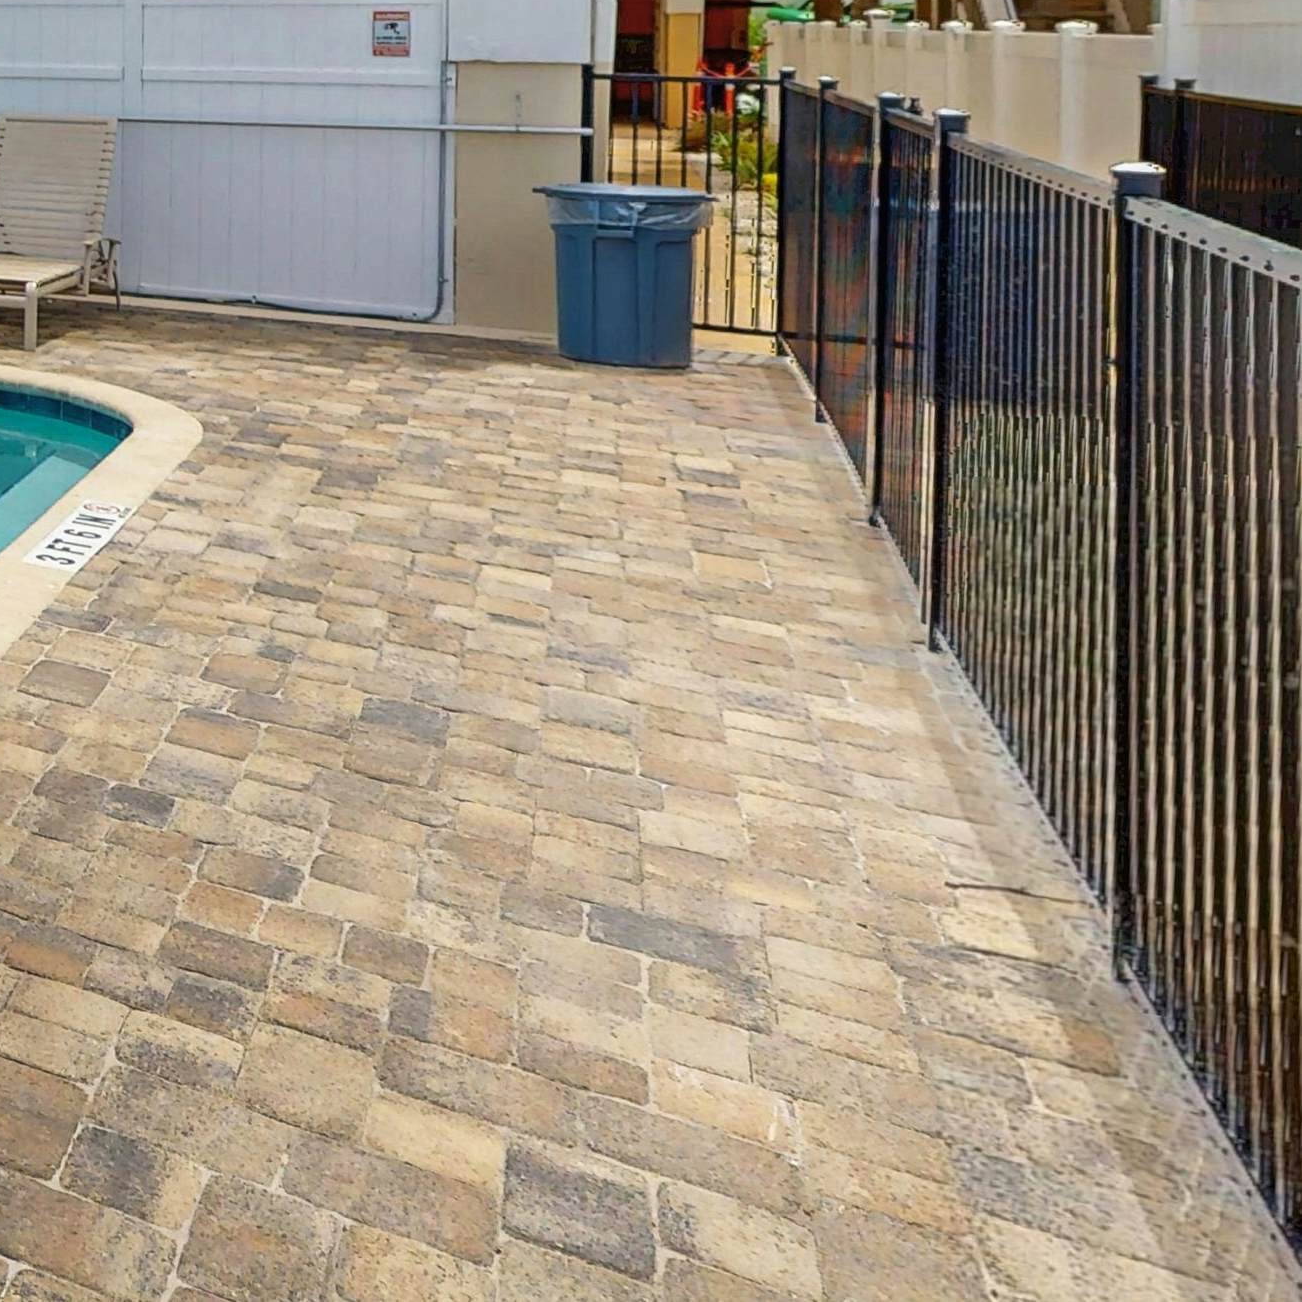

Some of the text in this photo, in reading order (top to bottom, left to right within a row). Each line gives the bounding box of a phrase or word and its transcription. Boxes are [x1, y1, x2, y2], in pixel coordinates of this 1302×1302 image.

[36, 514, 116, 565] 3 FT 6 IN
